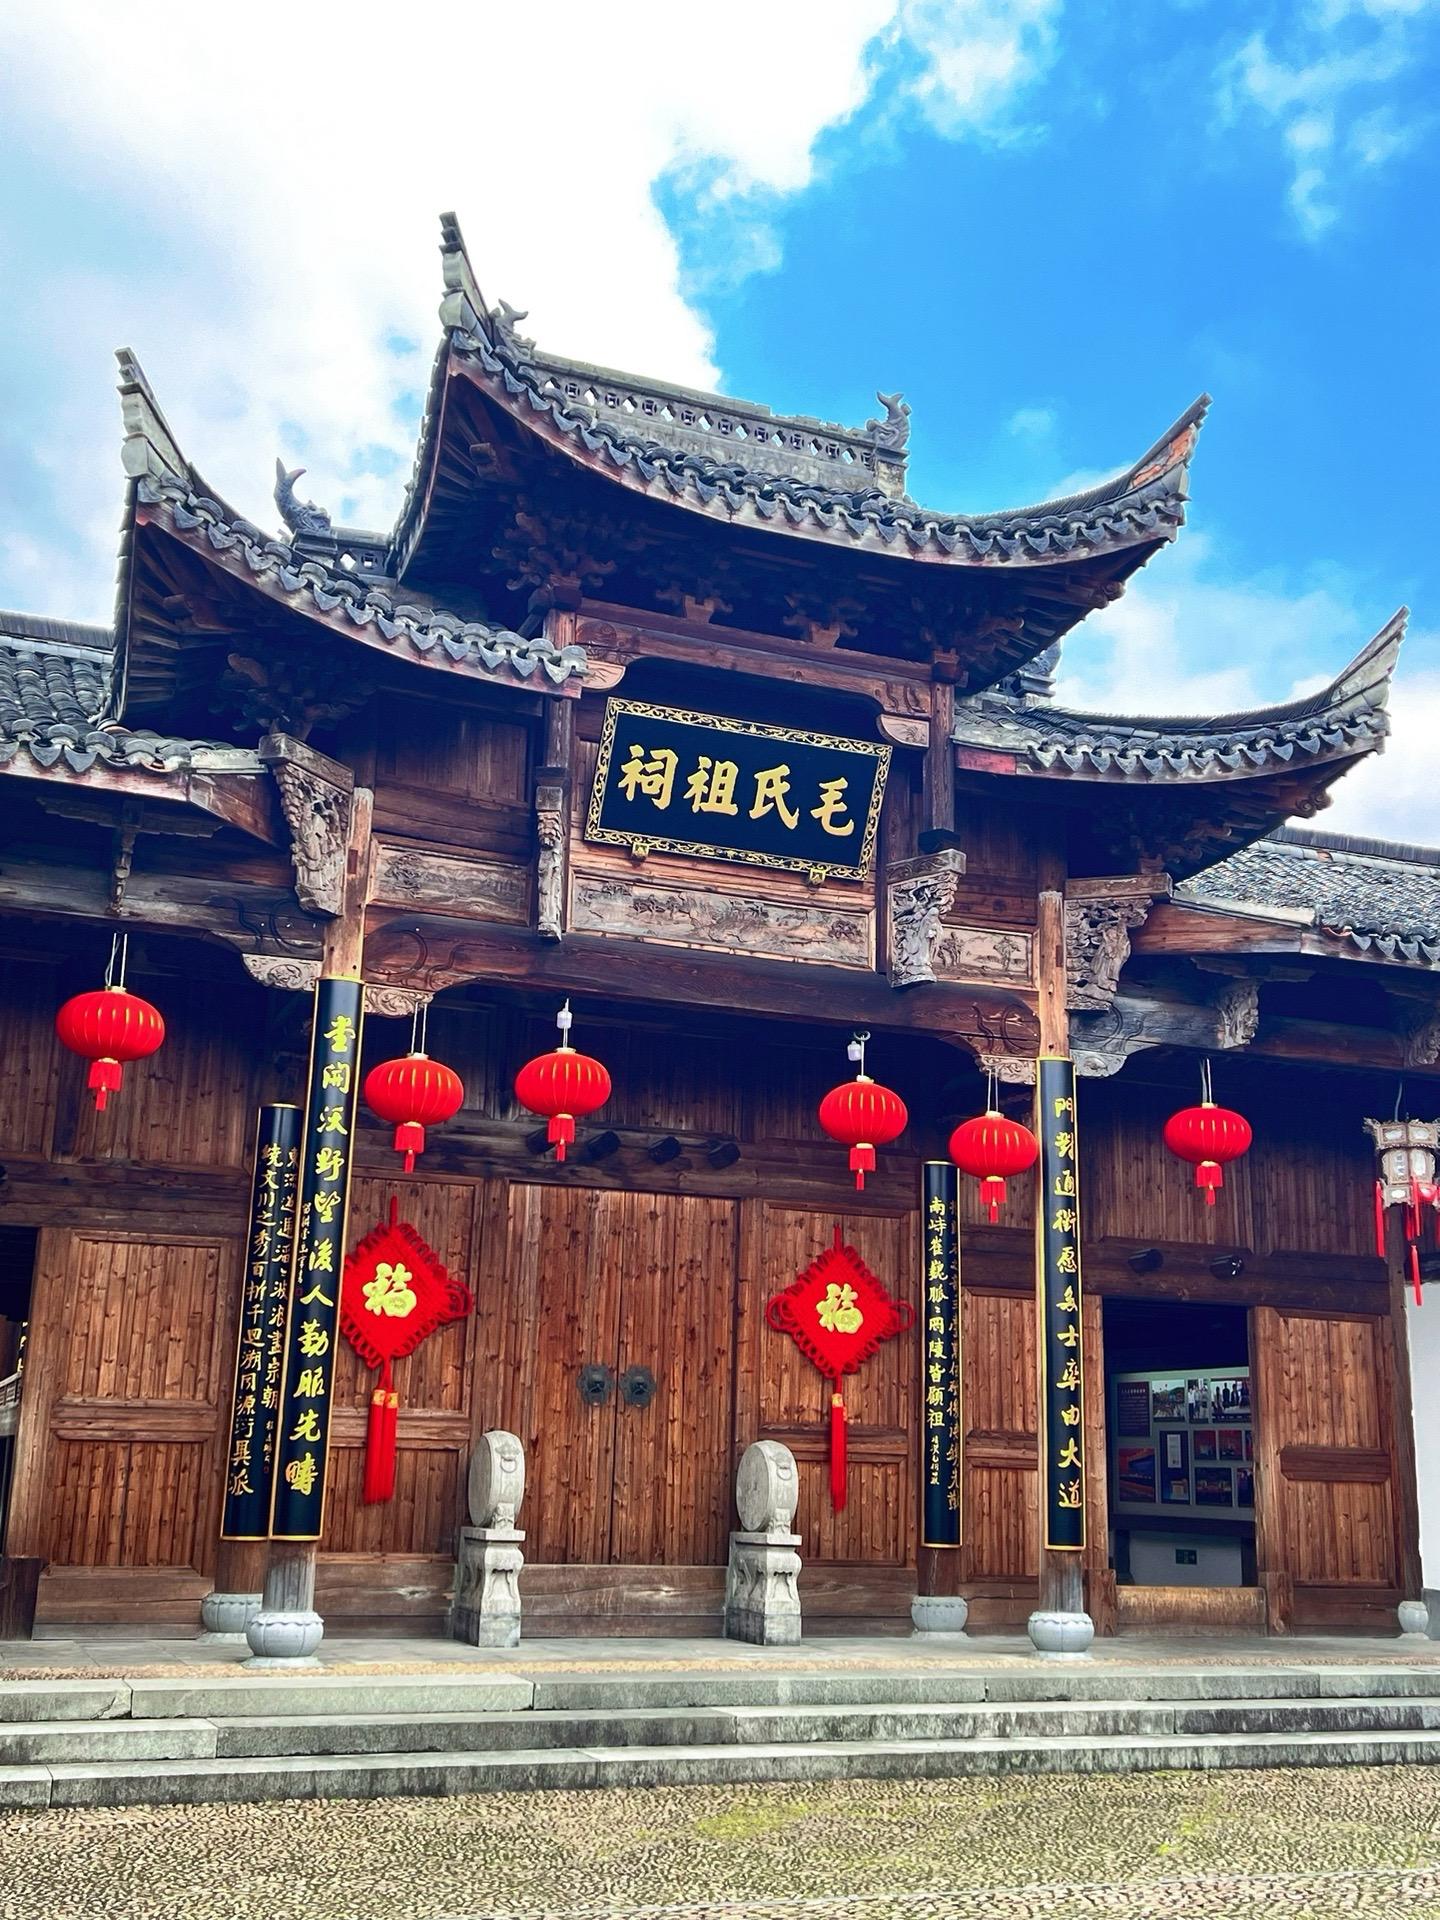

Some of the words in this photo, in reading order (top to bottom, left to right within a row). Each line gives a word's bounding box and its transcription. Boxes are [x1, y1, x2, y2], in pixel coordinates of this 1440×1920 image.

[618, 744, 855, 836] 毛氏祖祠
[362, 1262, 417, 1318] 福
[816, 1283, 863, 1334] 福
